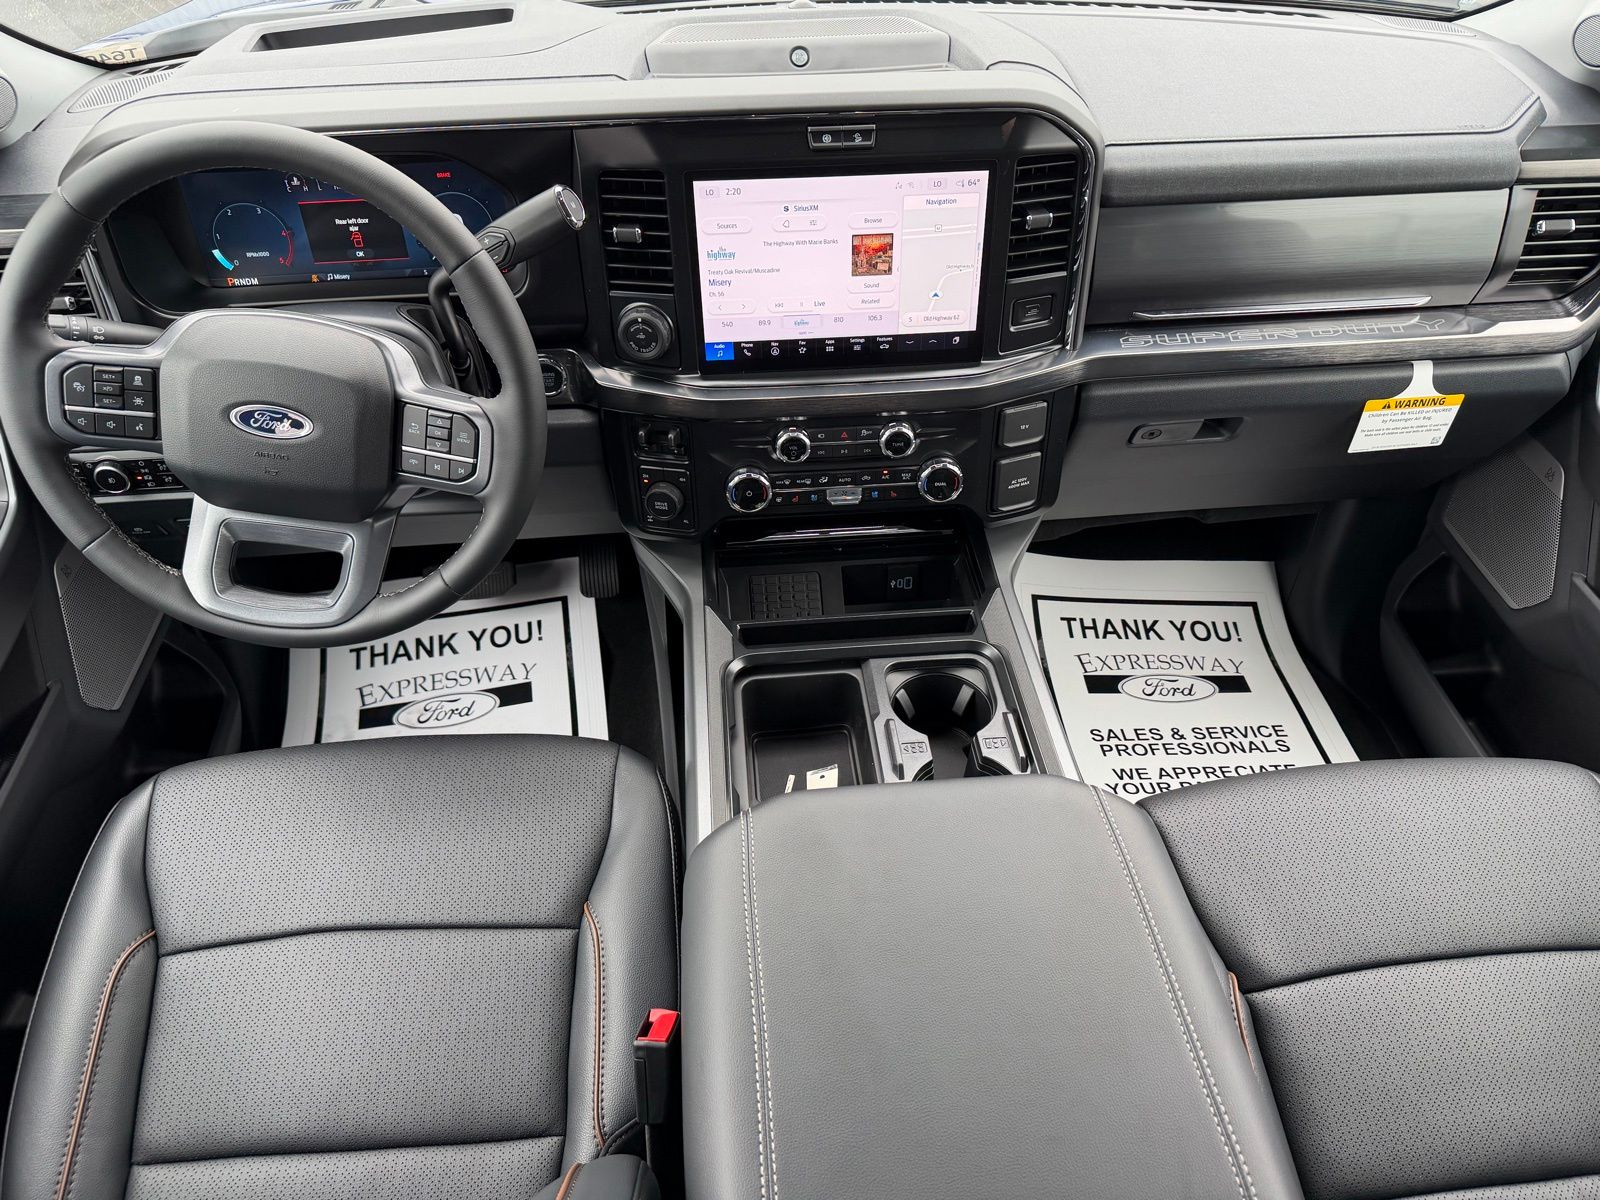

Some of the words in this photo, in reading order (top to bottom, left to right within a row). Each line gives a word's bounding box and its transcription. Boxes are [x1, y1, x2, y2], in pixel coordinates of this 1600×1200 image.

[725, 187, 742, 196] 2:20
[925, 197, 957, 207] Navigation
[716, 222, 738, 230] Sources
[773, 240, 795, 248] Highway
[706, 249, 736, 261] highway
[734, 267, 781, 275] Revival/Muscadine
[708, 278, 732, 288] Misery
[1119, 327, 1298, 348] SUPER
[1310, 318, 1446, 338] DUTY
[1394, 397, 1447, 409] WARNING
[250, 411, 292, 431] Ford
[1060, 616, 1164, 642] THANK
[1168, 619, 1243, 643] YOU!
[349, 631, 460, 671] THANK
[467, 619, 544, 652] YOU!
[1073, 652, 1245, 675] EXPRESSWAY
[355, 662, 538, 708] EXPRESSWAY
[1142, 678, 1197, 698] Ford
[416, 698, 475, 724] Ford
[1089, 727, 1164, 743] SALES
[1171, 727, 1186, 741] &
[1191, 724, 1289, 740] SERVICE
[1099, 739, 1291, 757] PROFESSIONALS
[1112, 767, 1153, 782] WE
[1104, 782, 1171, 795] YOUR
